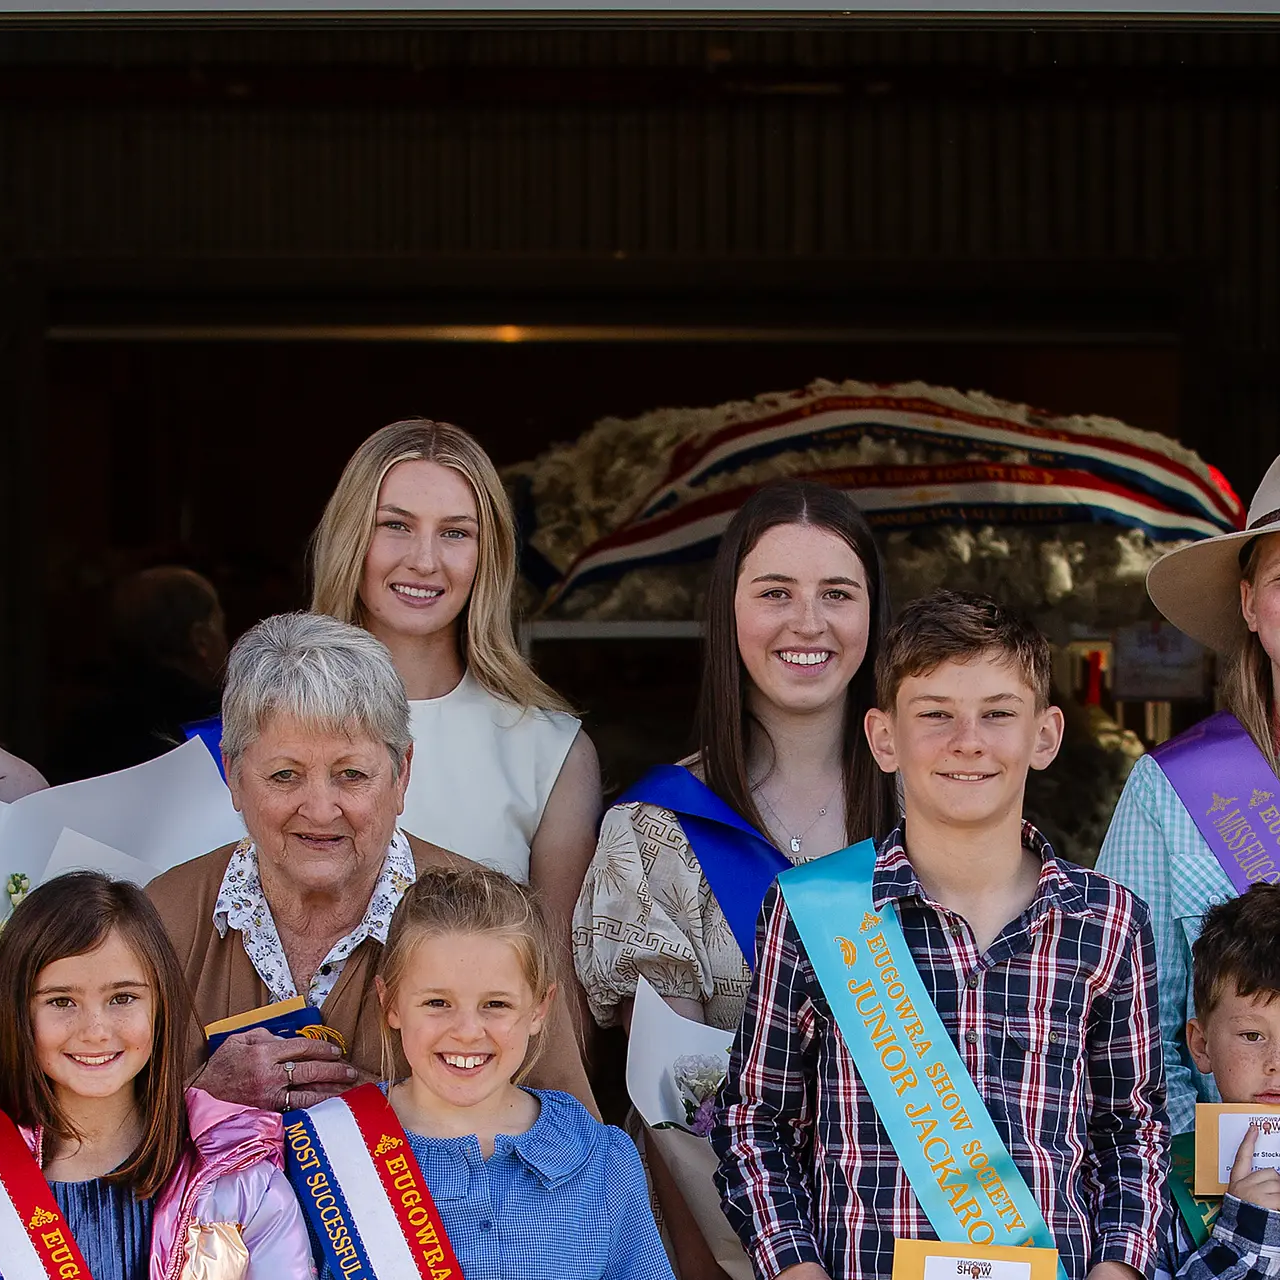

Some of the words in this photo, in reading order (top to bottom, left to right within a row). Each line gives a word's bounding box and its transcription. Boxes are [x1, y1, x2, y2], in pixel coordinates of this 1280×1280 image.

[1212, 809, 1256, 851] MISS
[847, 978, 919, 1097] JUNIOR
[866, 931, 933, 1060] EUGOWRA
[924, 1061, 974, 1132] SHOW
[961, 1139, 1026, 1233] SOCIETY
[284, 1121, 321, 1171] MOST
[306, 1172, 362, 1280] SUCCESSFUL
[957, 1265, 992, 1276] SHOW
